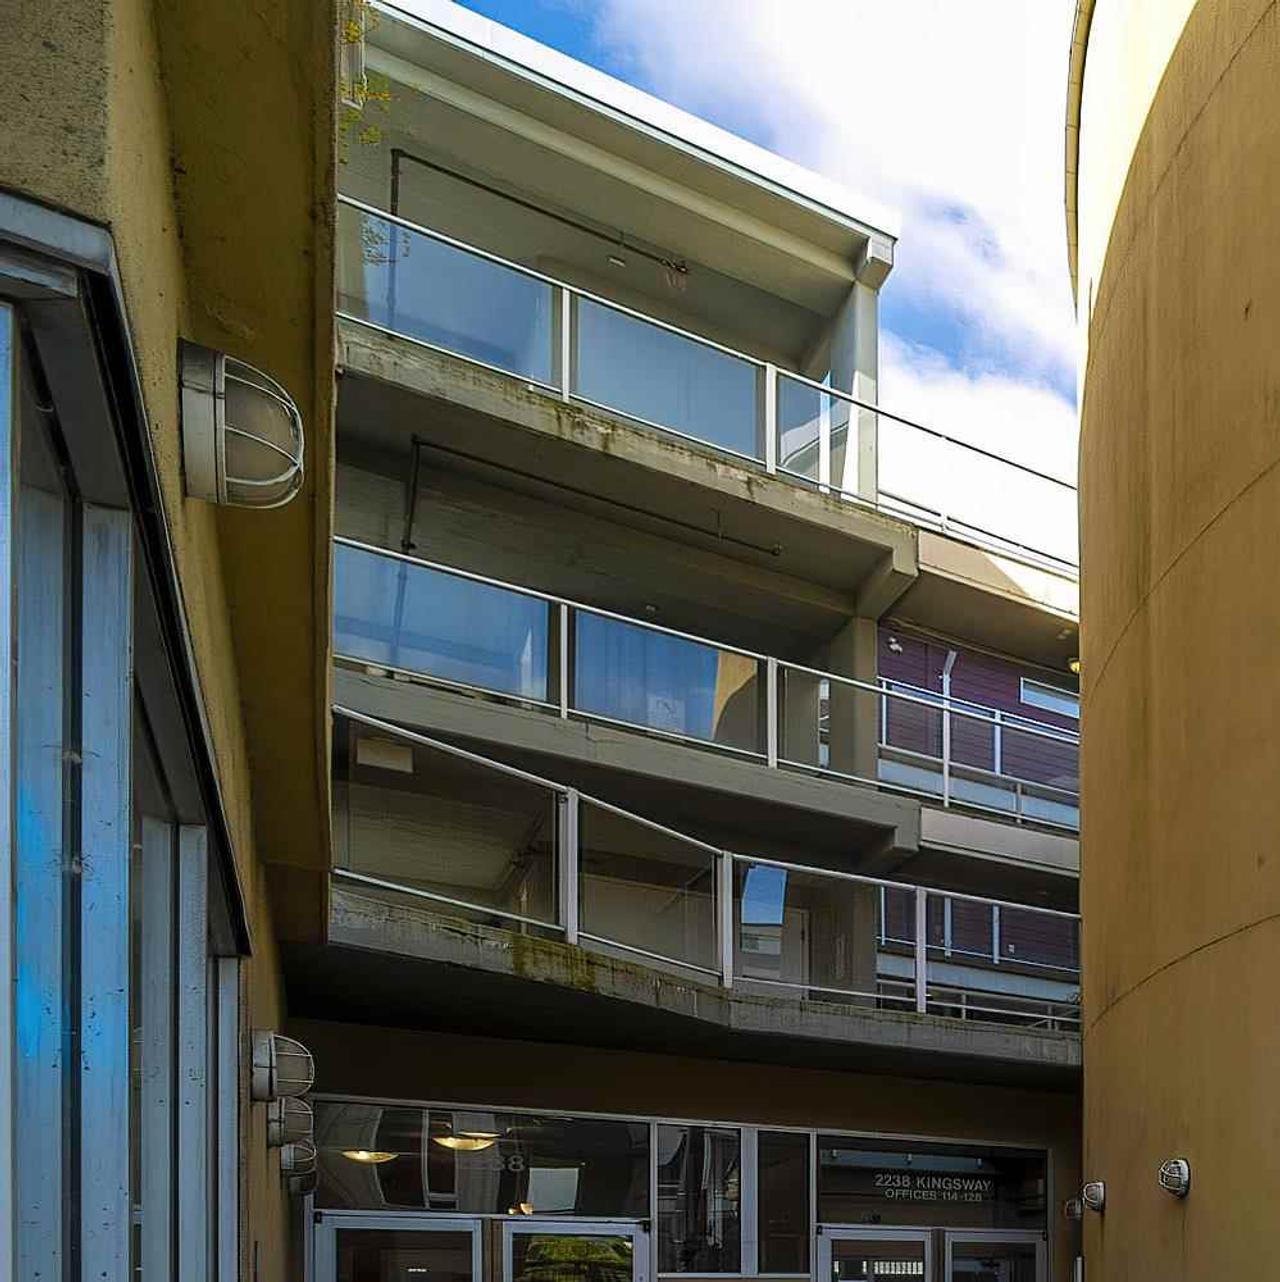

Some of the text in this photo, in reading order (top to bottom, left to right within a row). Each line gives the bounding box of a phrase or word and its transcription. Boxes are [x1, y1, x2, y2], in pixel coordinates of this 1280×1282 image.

[875, 1173, 993, 1192] 2238 KINGSWAY
[885, 1188, 937, 1201] OFFICES
